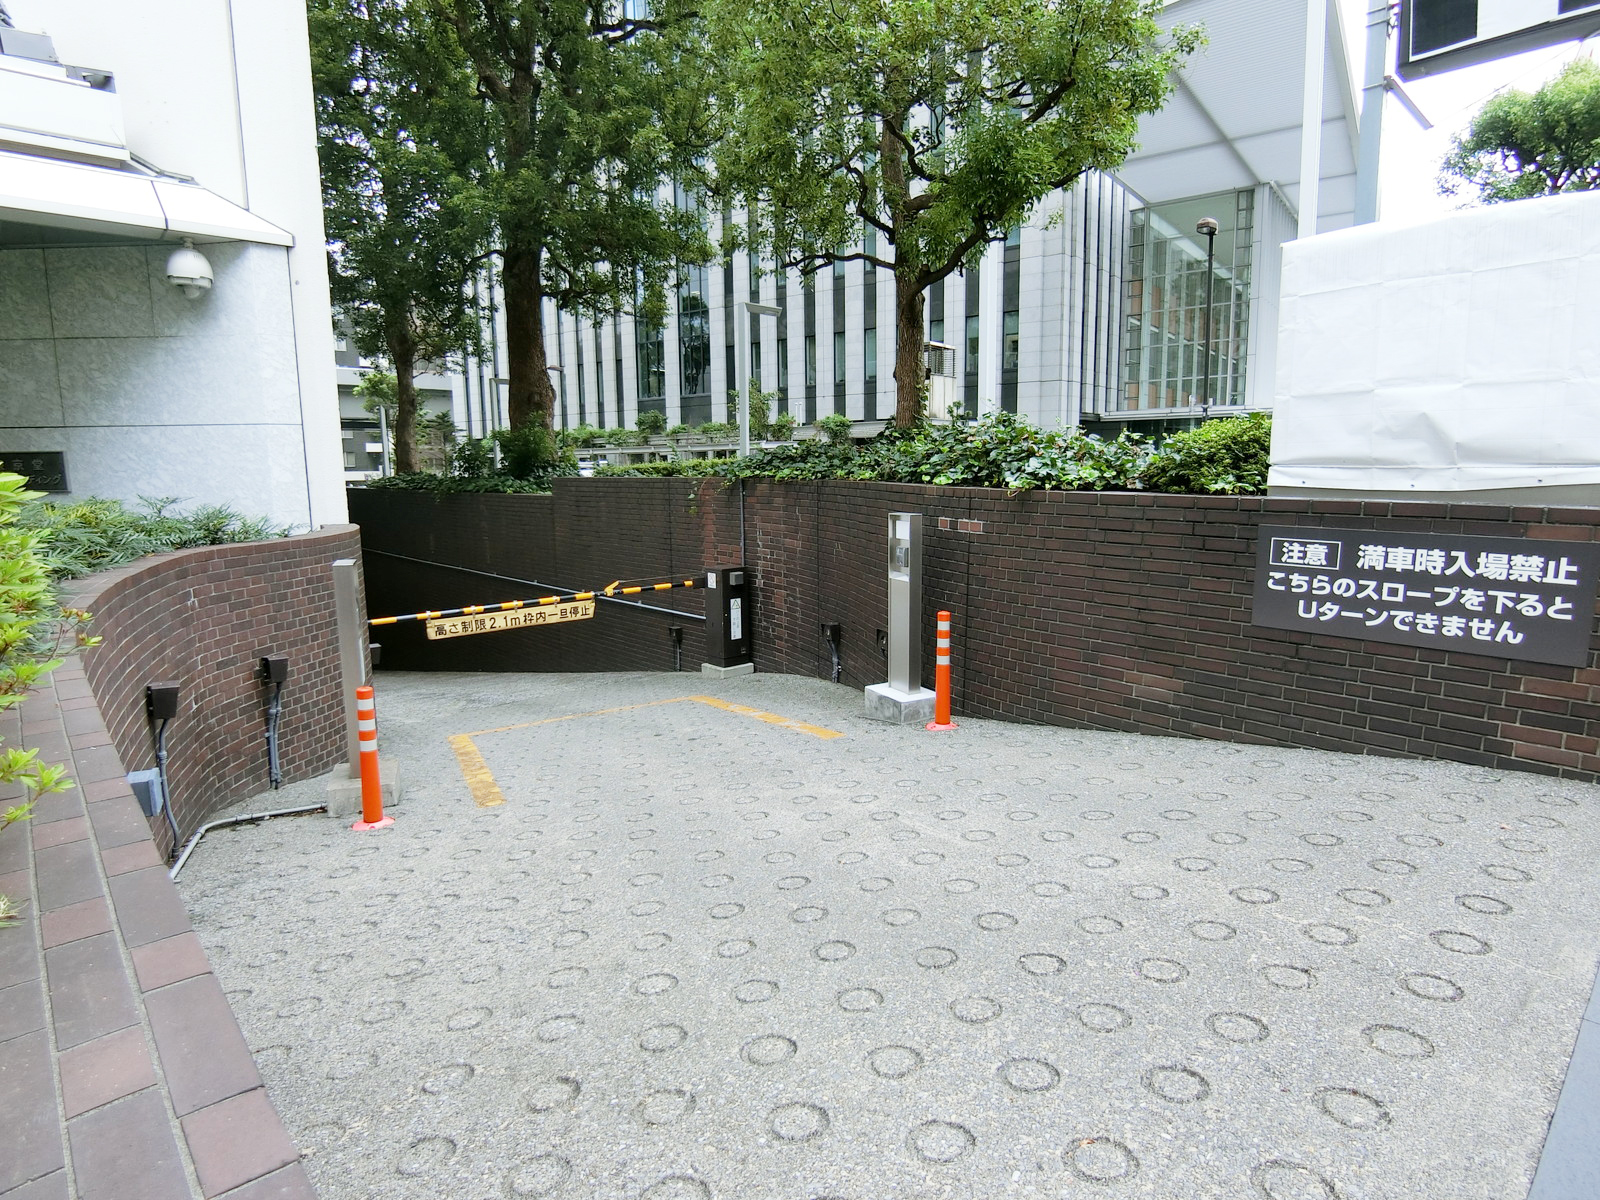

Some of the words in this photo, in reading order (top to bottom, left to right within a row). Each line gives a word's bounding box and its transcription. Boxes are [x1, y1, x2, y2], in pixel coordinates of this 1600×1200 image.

[1281, 541, 1329, 565] 注意
[1356, 544, 1578, 586] 満車時入場禁止
[1266, 571, 1573, 620] こちらのスロープを下ると
[1297, 600, 1524, 645] Uターンできません
